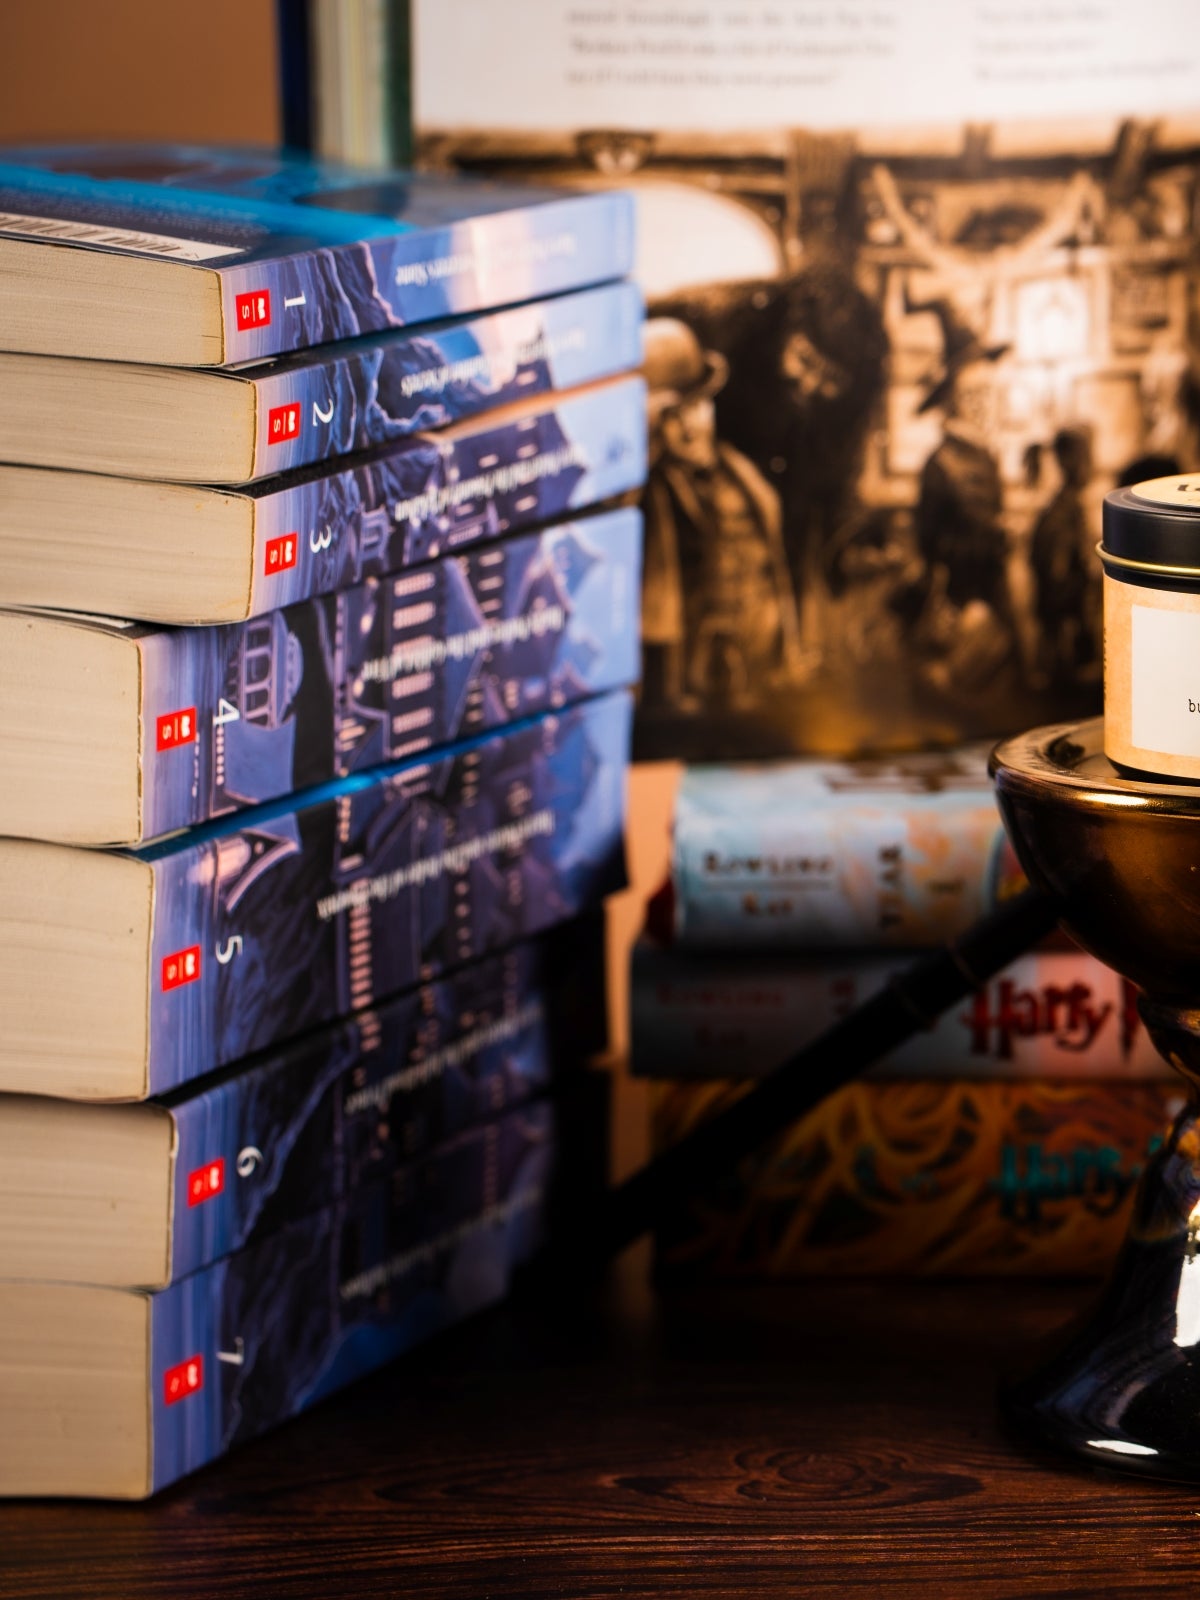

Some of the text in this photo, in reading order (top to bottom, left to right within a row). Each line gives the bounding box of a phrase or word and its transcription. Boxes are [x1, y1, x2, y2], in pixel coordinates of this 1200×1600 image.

[284, 293, 306, 309] 1
[311, 399, 334, 426] 2
[309, 524, 332, 553] 3
[212, 697, 241, 729] 4
[215, 934, 243, 967] 5
[959, 976, 1111, 1060] Harry
[237, 1146, 263, 1177] 6
[216, 1337, 244, 1366] 7
